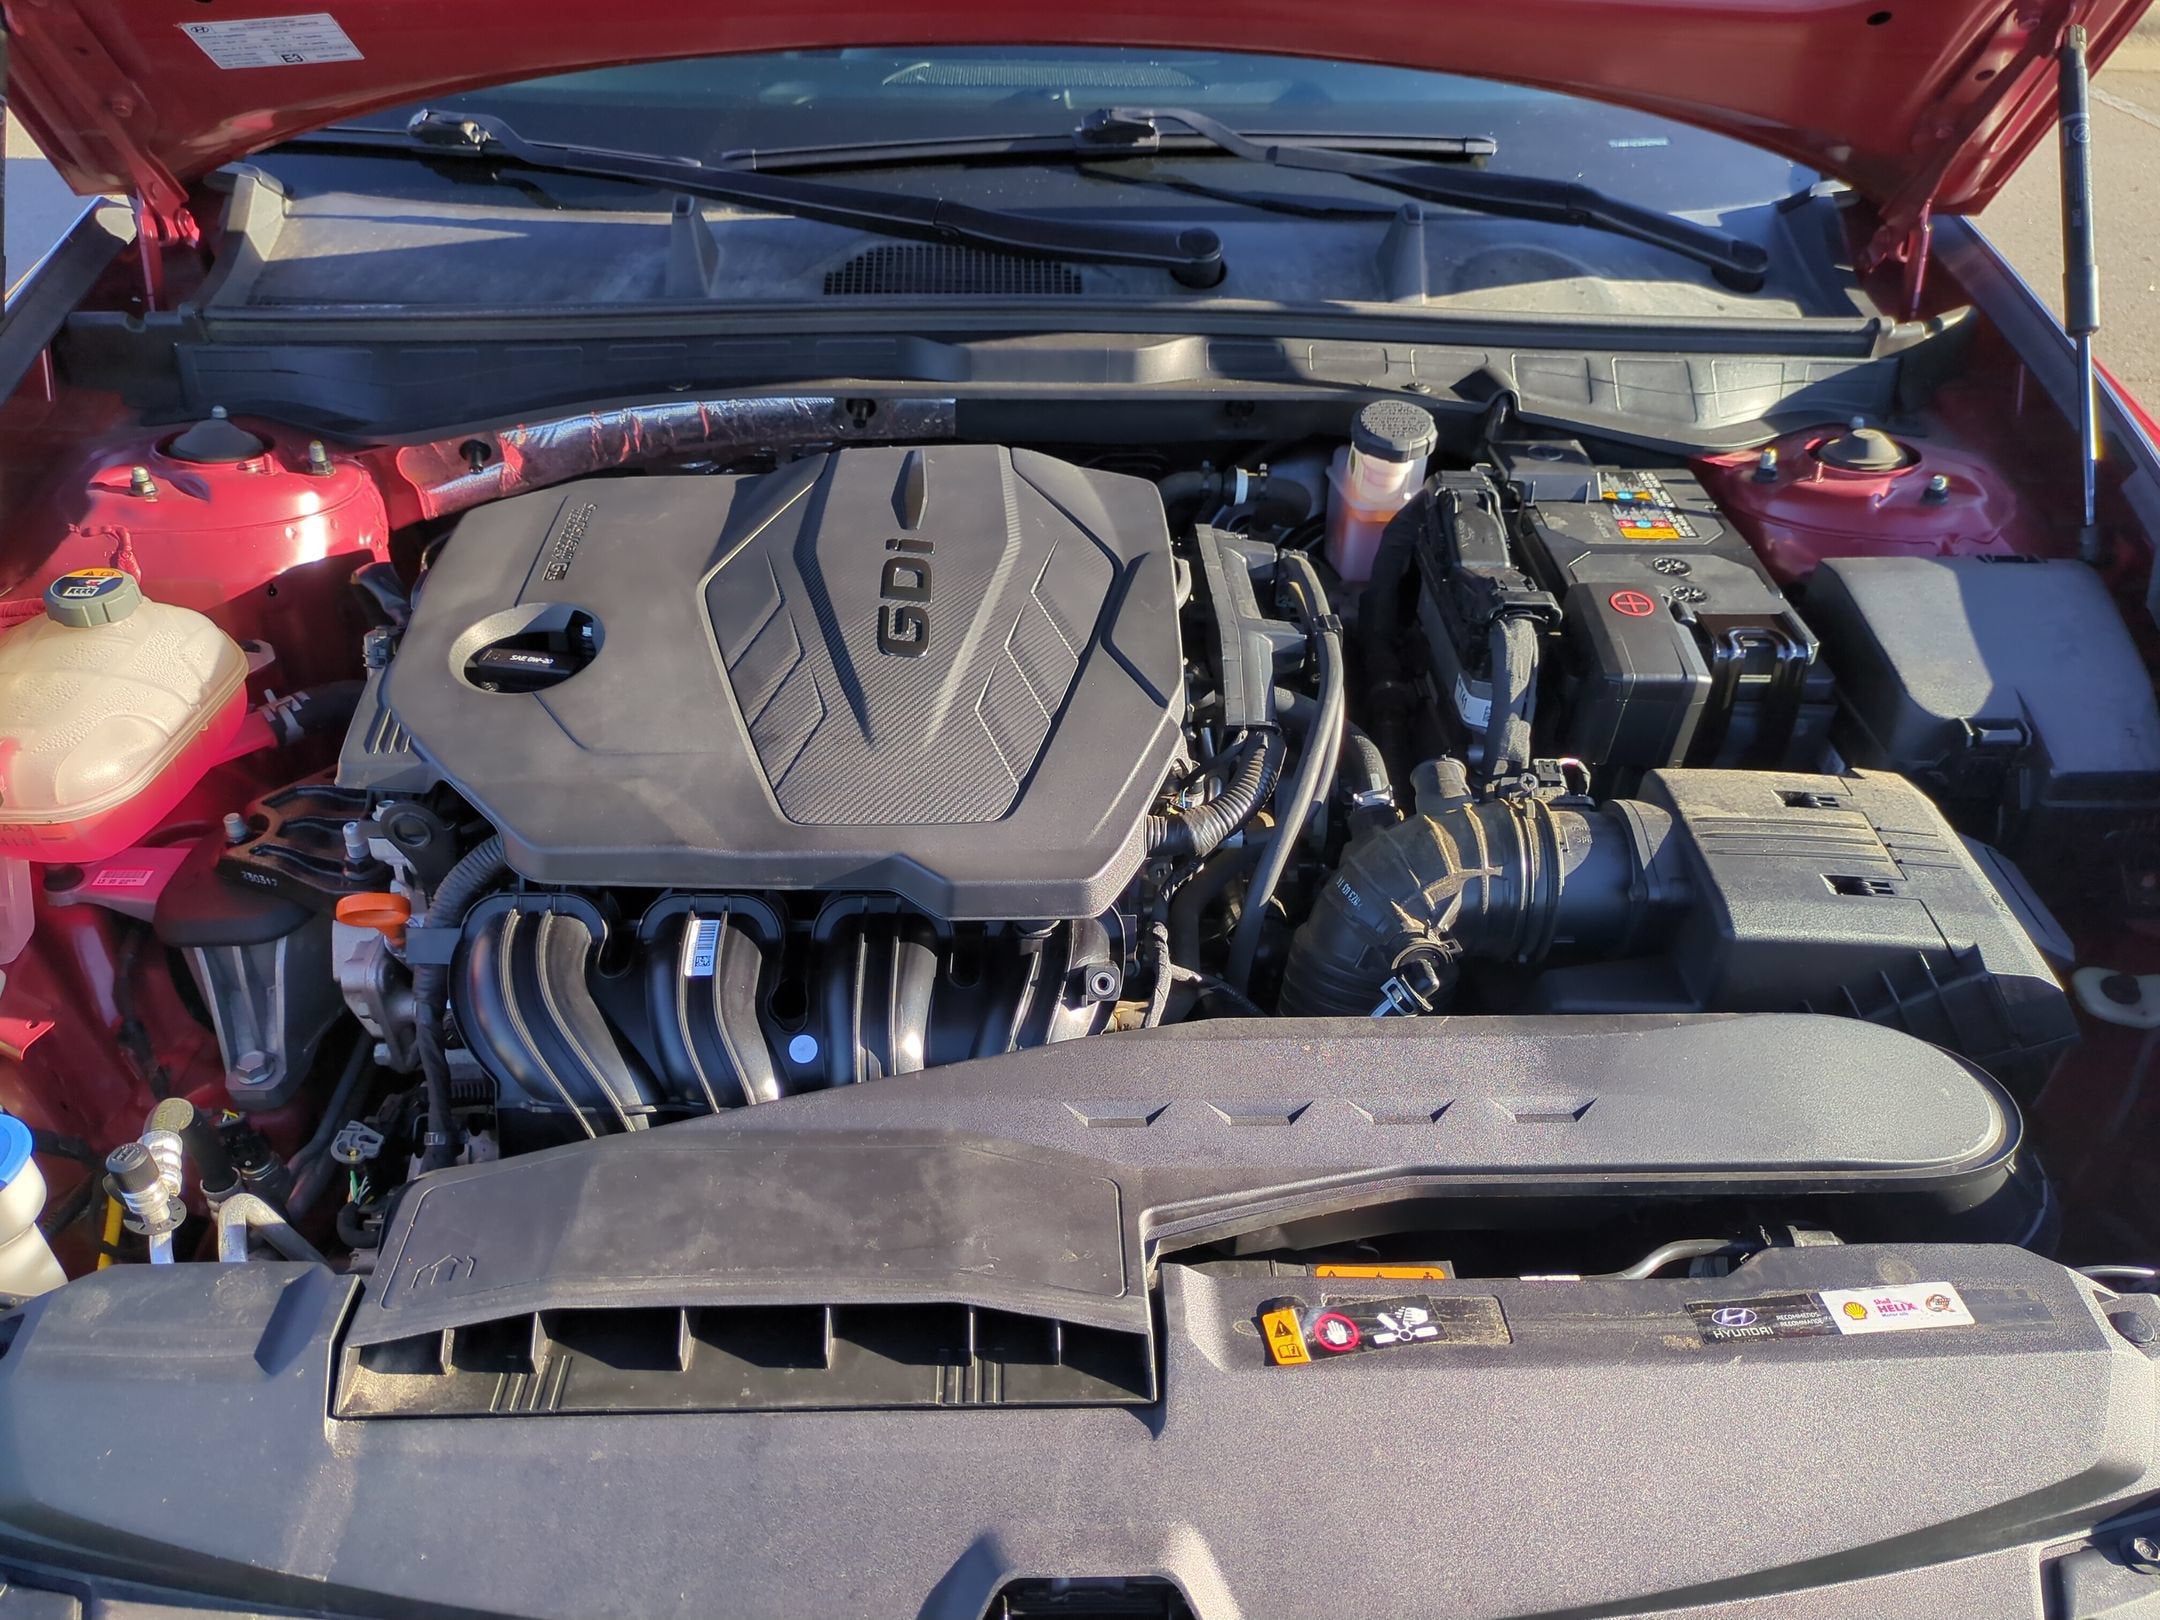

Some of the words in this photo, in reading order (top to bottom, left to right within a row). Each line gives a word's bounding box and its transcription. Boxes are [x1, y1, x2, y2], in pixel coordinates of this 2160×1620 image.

[877, 538, 935, 658] GDi
[510, 654, 527, 662] SAE
[1877, 1302, 1915, 1313] HELIX
[1712, 1326, 1774, 1340] HYUNDAI
